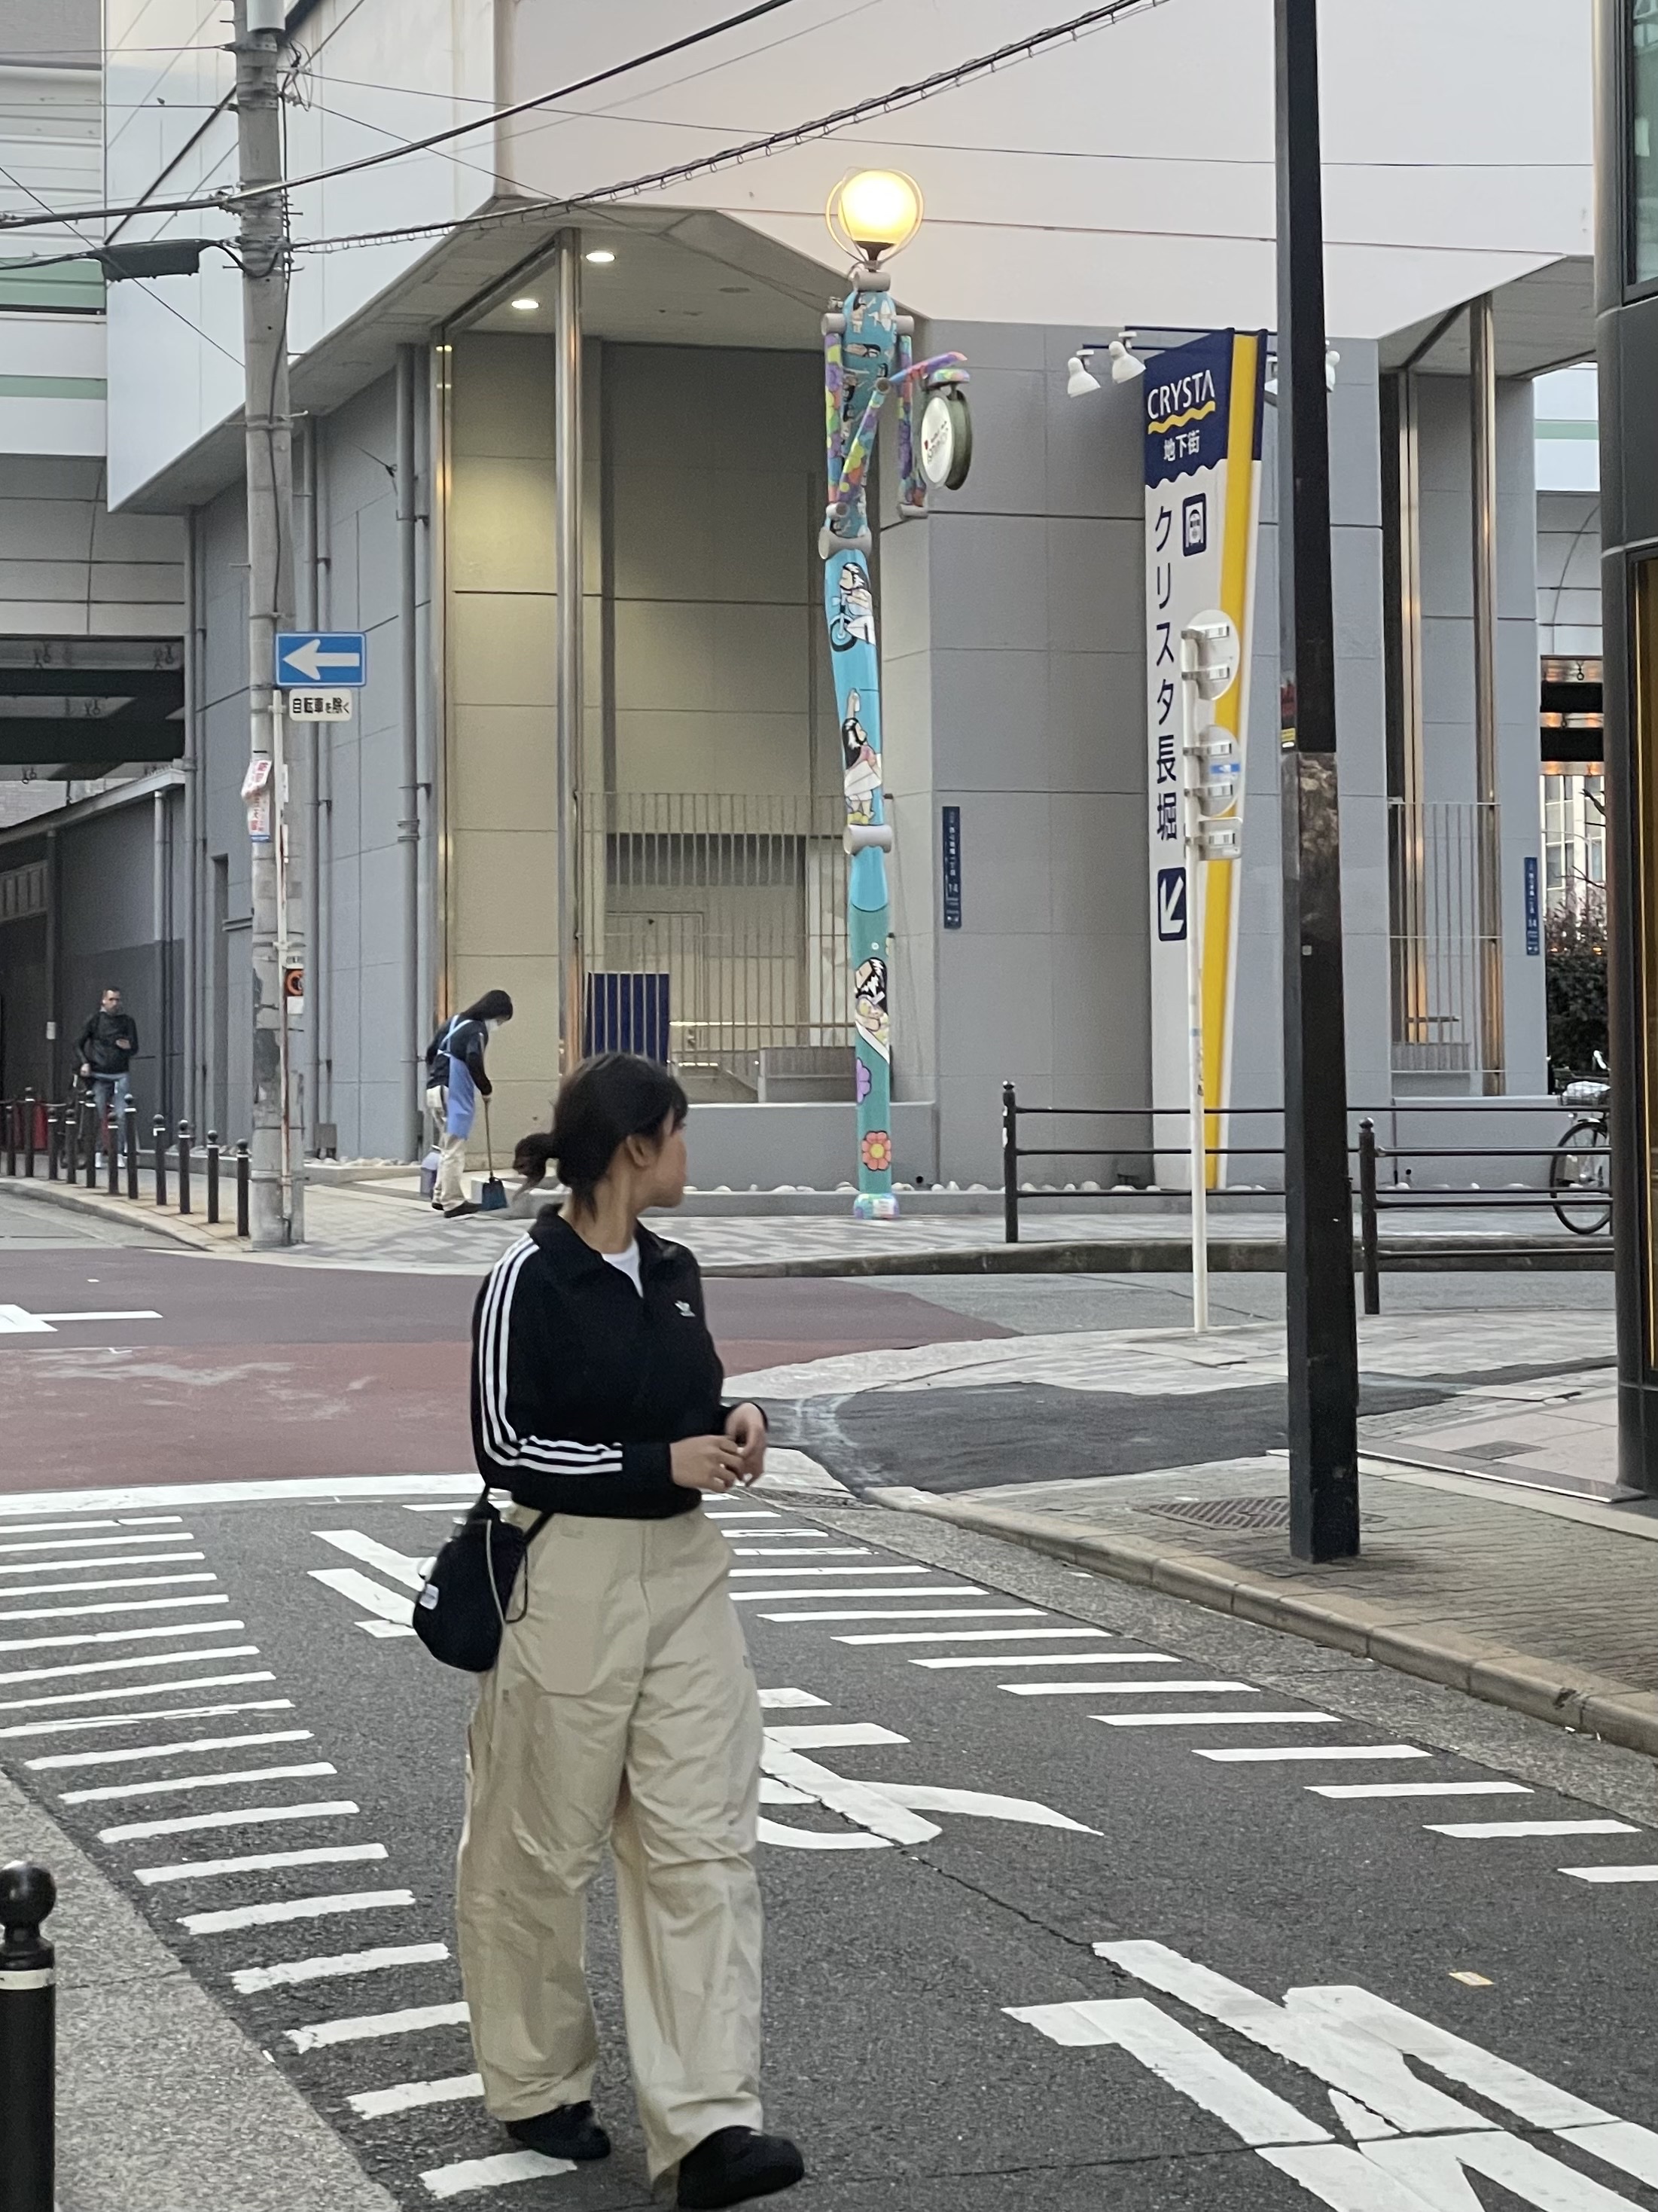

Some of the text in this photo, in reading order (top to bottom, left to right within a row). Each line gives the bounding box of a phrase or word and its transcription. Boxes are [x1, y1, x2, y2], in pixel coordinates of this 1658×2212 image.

[1147, 369, 1215, 420] CRYSTA
[1154, 505, 1177, 841] クリスタ長堀
[292, 697, 350, 714] 自転車を除く
